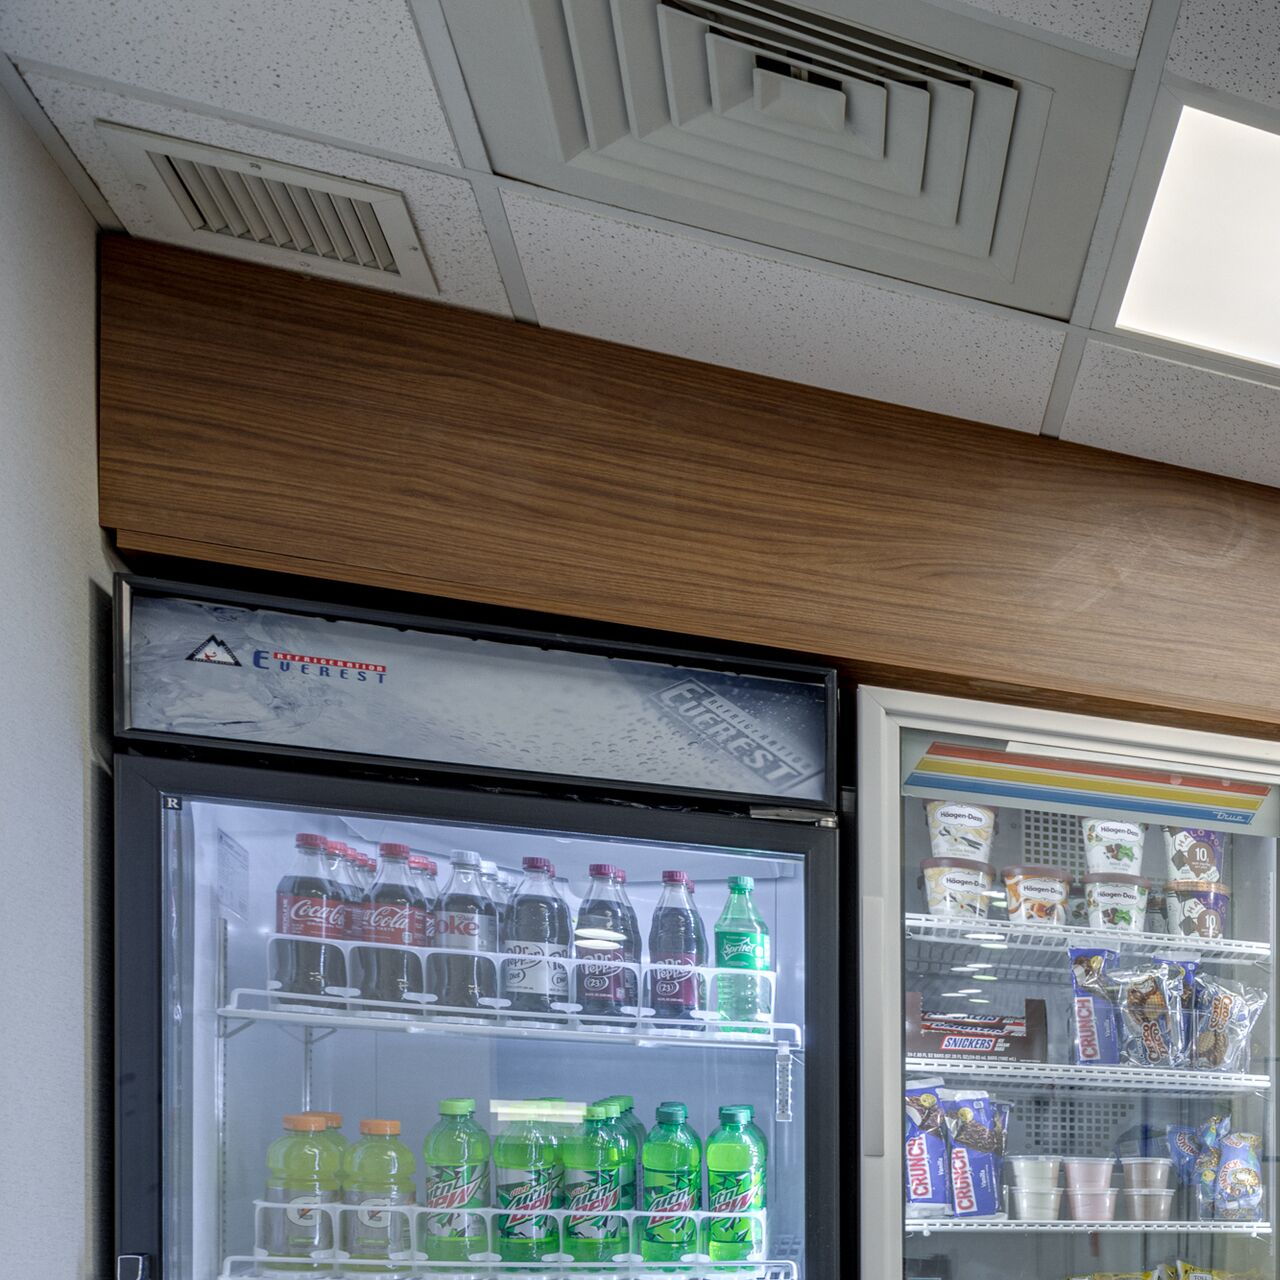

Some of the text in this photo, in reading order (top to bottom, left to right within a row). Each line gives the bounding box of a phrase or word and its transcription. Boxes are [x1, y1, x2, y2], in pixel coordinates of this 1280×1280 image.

[944, 1037, 993, 1049] SNICKERS
[1077, 998, 1098, 1059] CRUNCH
[908, 1136, 930, 1197] CRUNCH
[952, 1149, 974, 1211] CRUNCH
